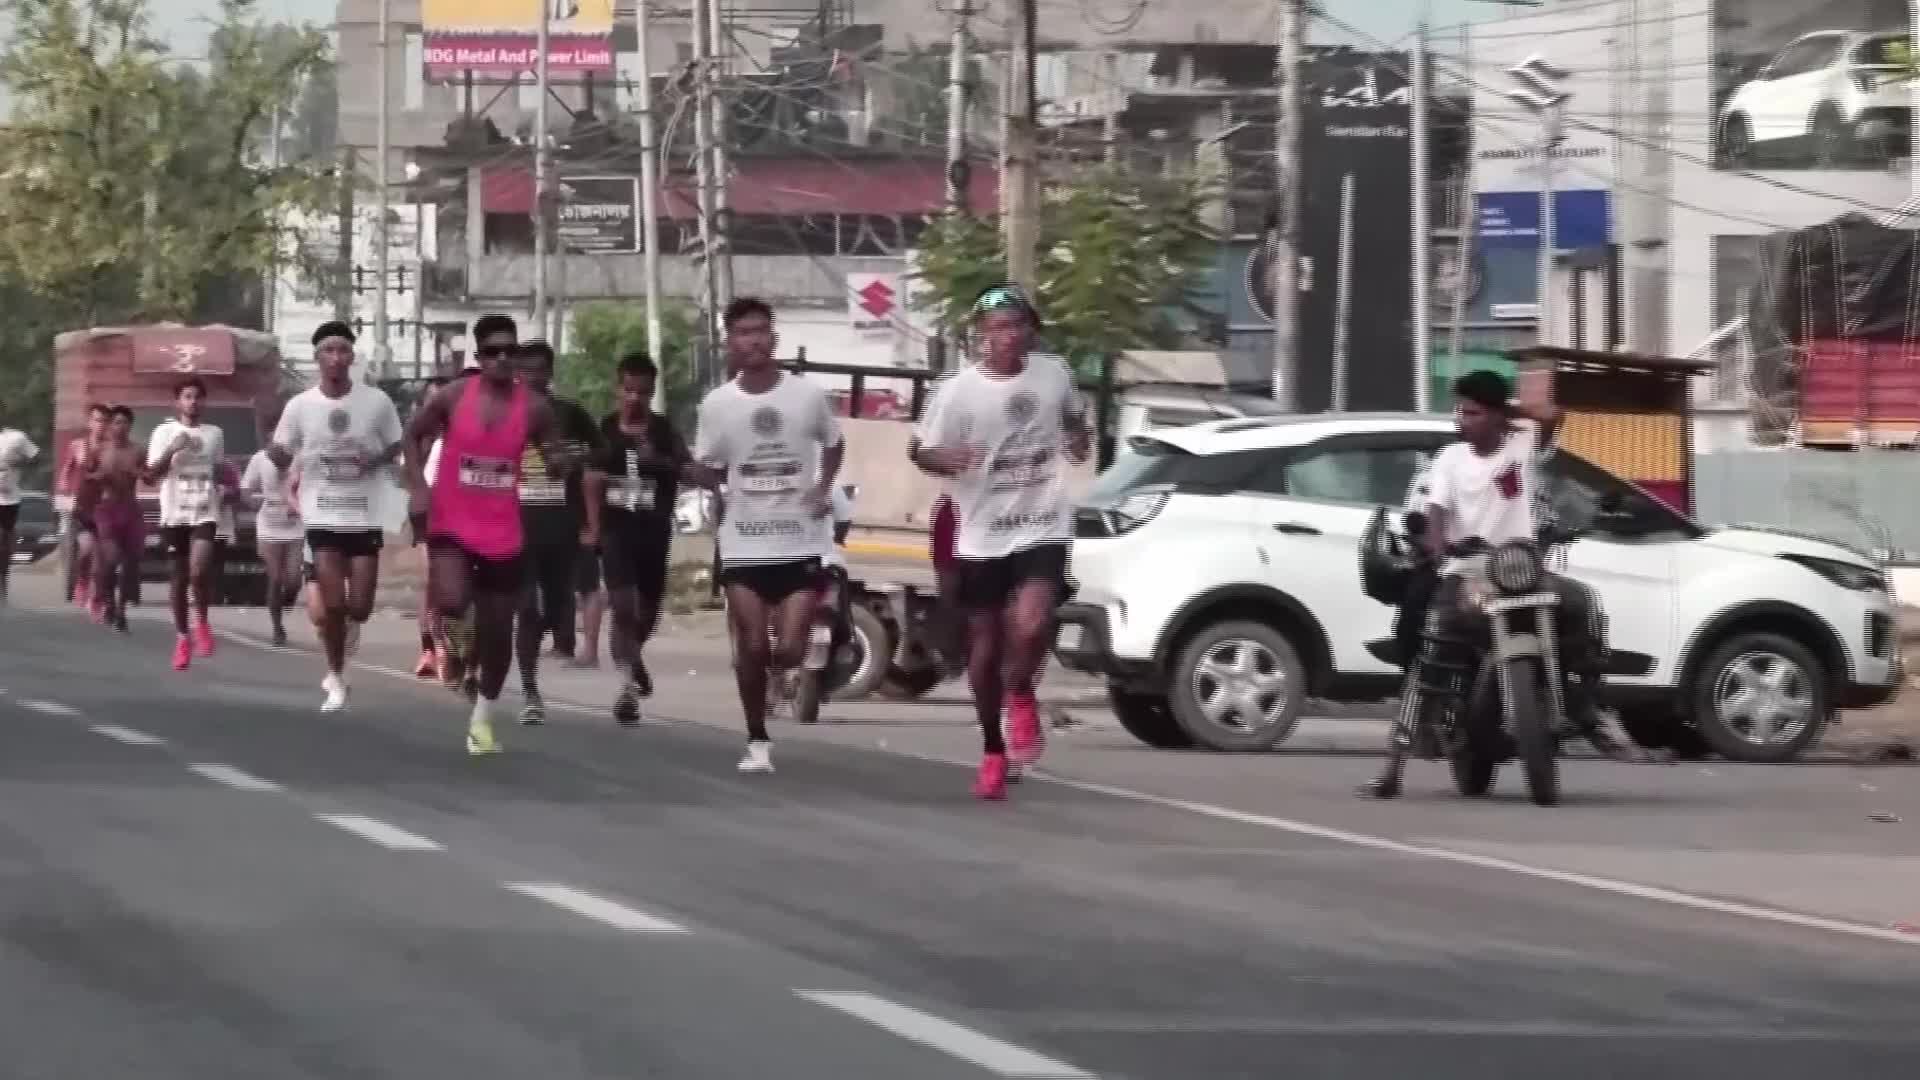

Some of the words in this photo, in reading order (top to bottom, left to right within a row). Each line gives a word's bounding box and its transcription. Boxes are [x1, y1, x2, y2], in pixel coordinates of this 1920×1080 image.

[456, 47, 496, 63] Metal
[498, 48, 527, 63] And
[528, 48, 572, 63] Pwer
